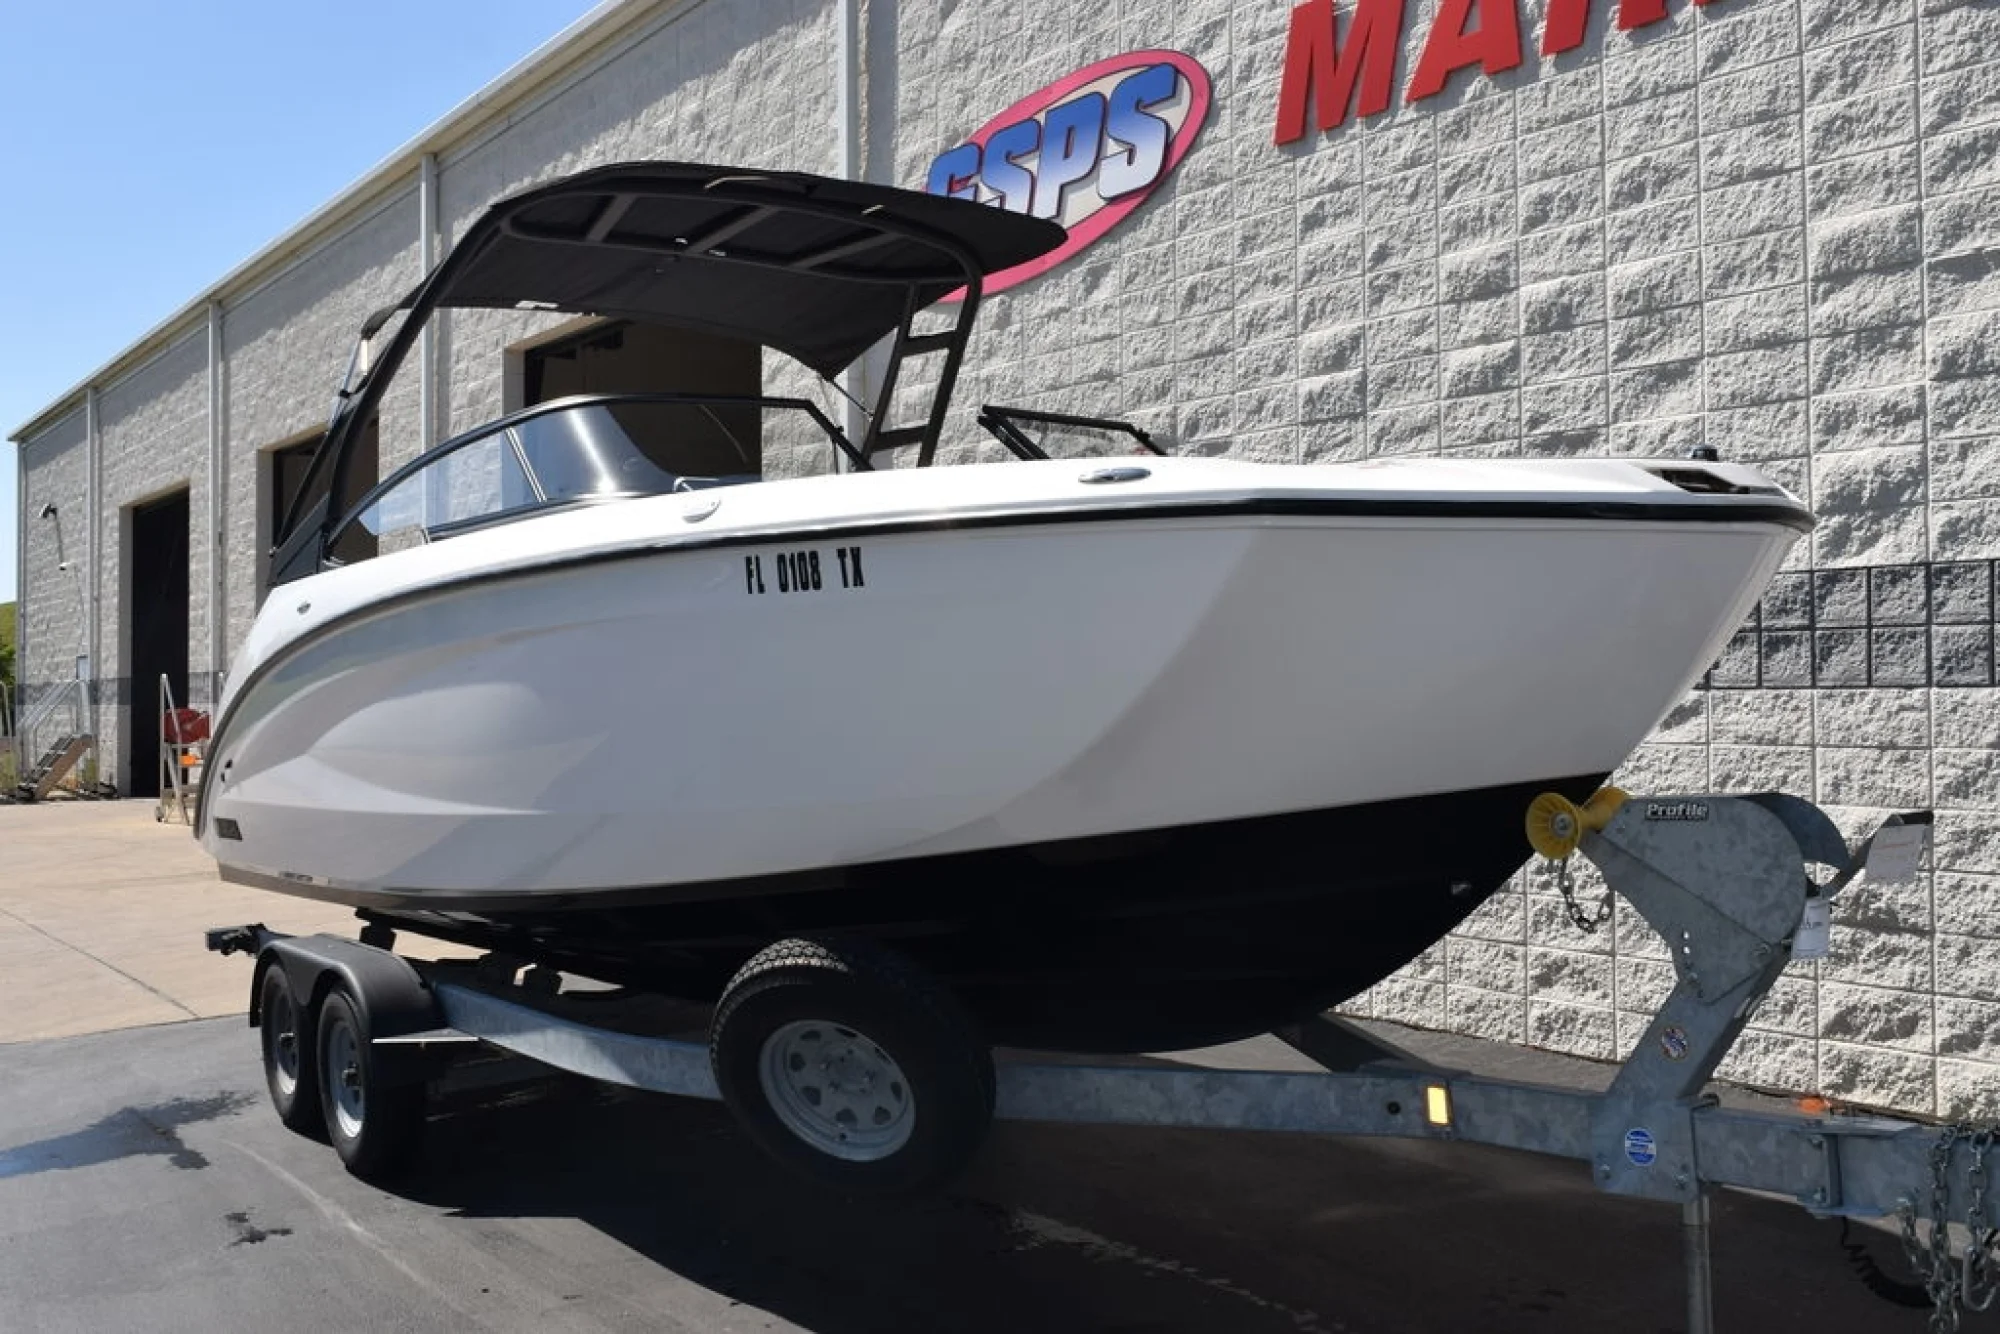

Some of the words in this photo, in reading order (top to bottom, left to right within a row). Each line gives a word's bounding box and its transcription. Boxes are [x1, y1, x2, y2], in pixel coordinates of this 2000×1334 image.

[745, 554, 766, 594] FL
[776, 550, 822, 593] 0108
[836, 546, 865, 588] TX
[1647, 803, 1708, 816] Profile
